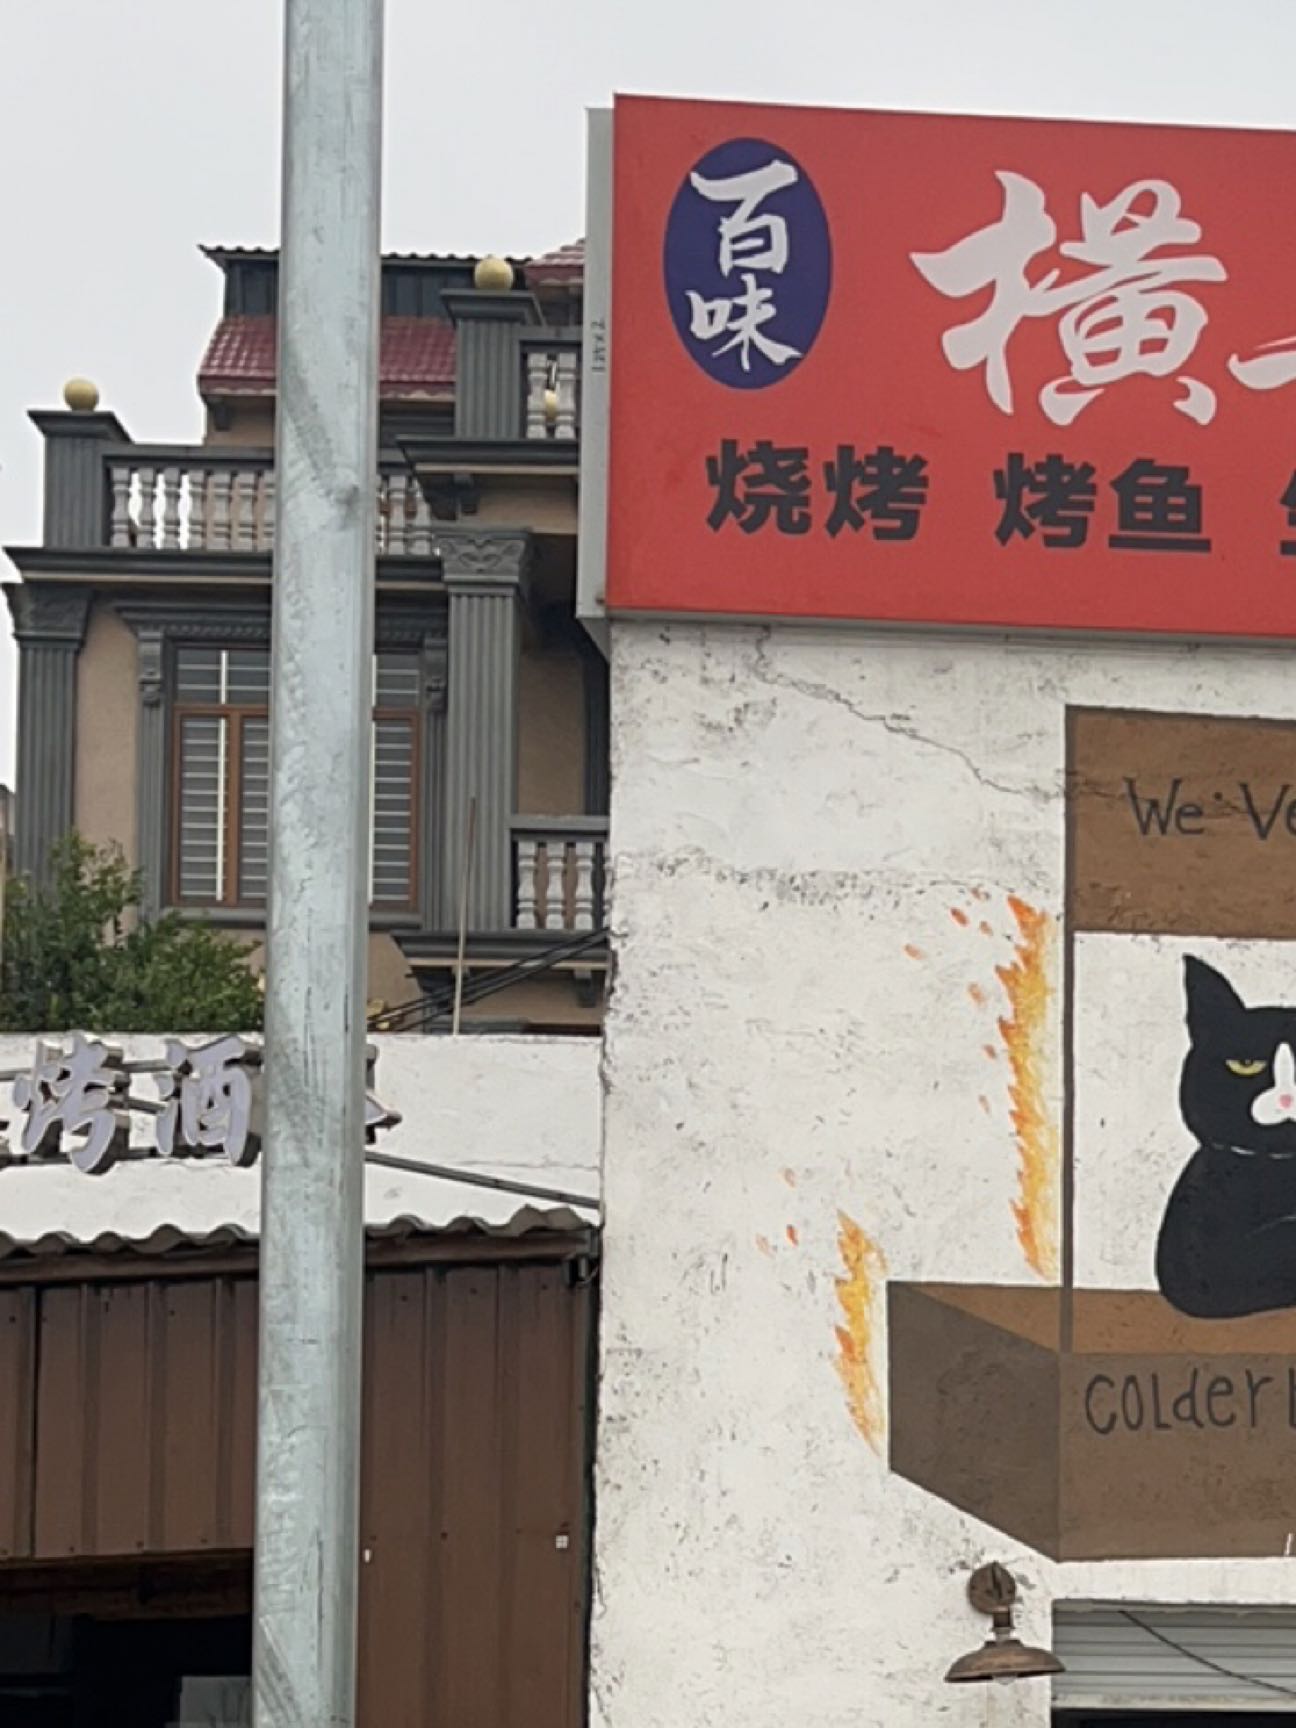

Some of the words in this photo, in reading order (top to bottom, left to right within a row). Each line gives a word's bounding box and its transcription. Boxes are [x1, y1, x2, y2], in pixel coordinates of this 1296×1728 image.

[684, 160, 803, 370] 百味
[705, 438, 930, 543] 烧烤
[991, 452, 1212, 553] 烤鱼
